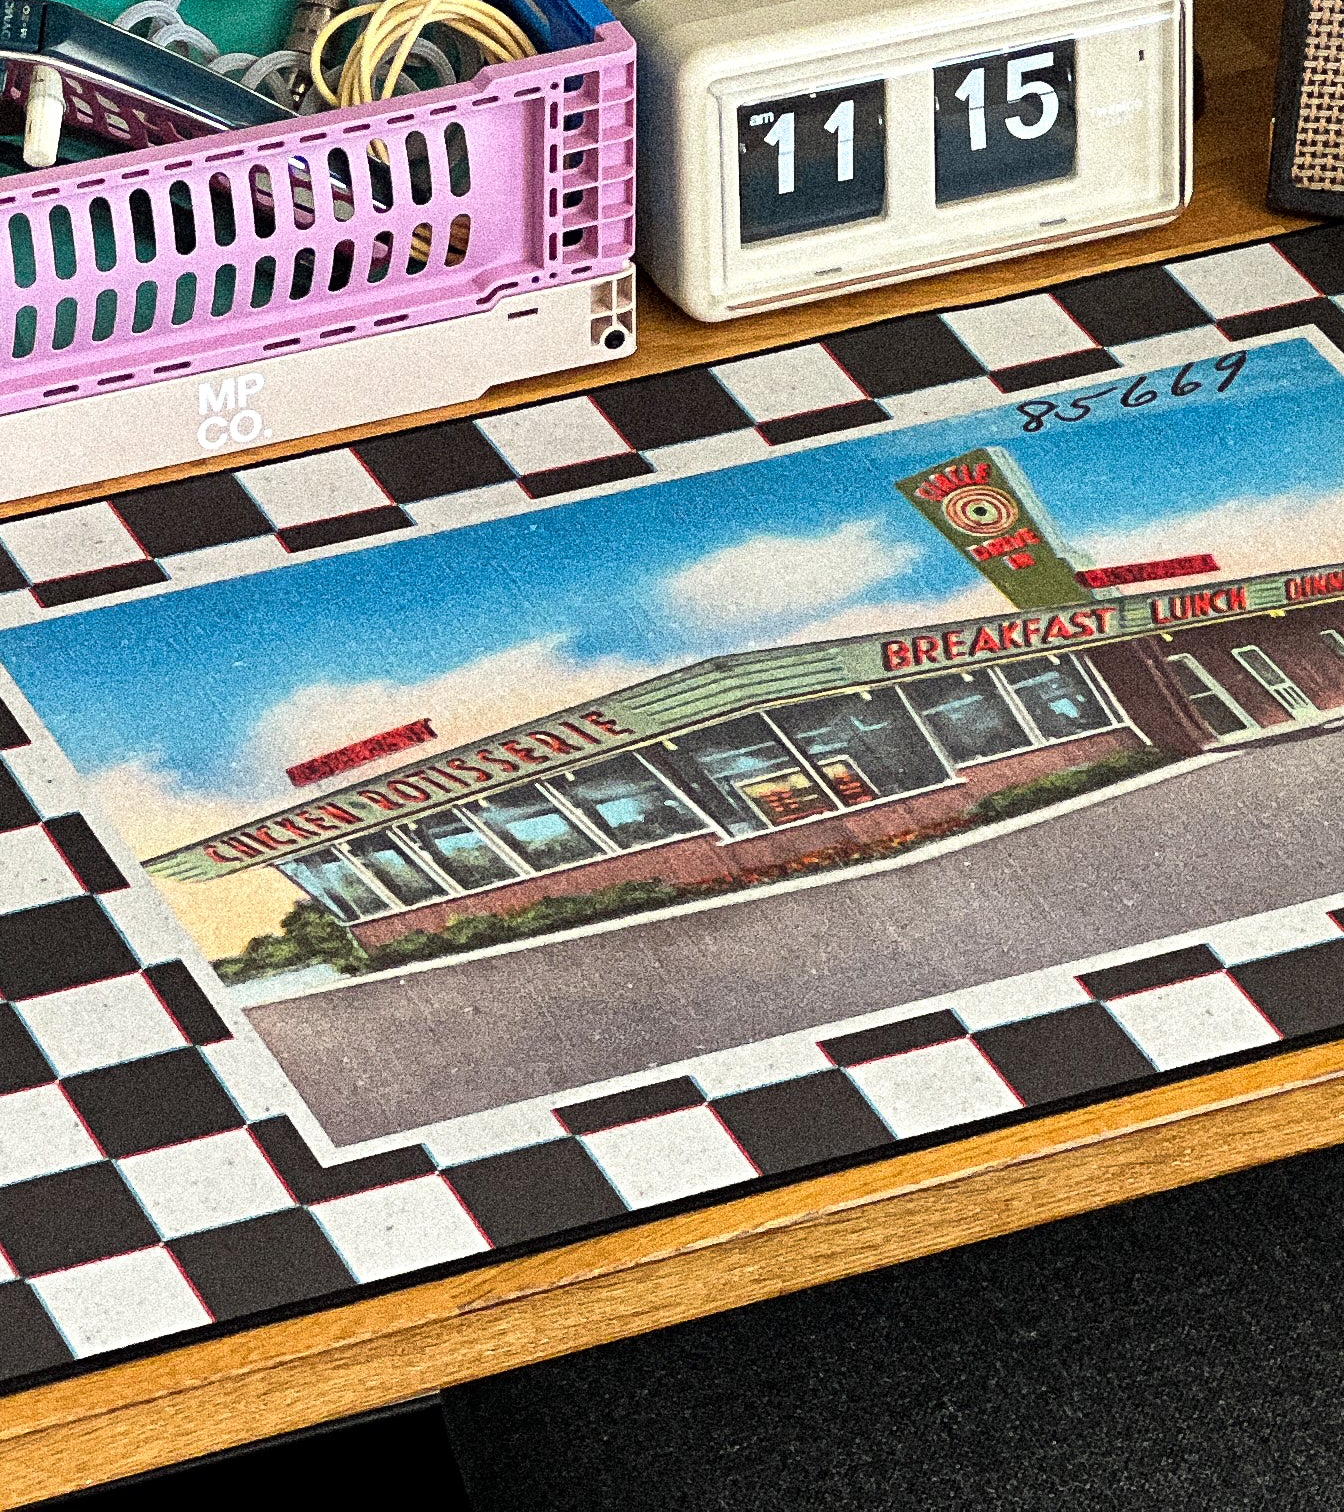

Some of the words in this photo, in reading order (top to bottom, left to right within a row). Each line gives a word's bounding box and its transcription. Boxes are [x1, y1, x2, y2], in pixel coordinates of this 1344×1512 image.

[749, 110, 774, 127] am
[764, 99, 855, 195] 11
[955, 51, 1060, 151] 15
[196, 409, 273, 449] CO.
[198, 372, 265, 415] MP
[1016, 350, 1248, 433] 85669
[882, 607, 1116, 672] BREAKFAST
[1151, 587, 1248, 624] LUNCH
[203, 801, 366, 863] CHICKEN
[360, 710, 636, 811] ROTISSERIE
